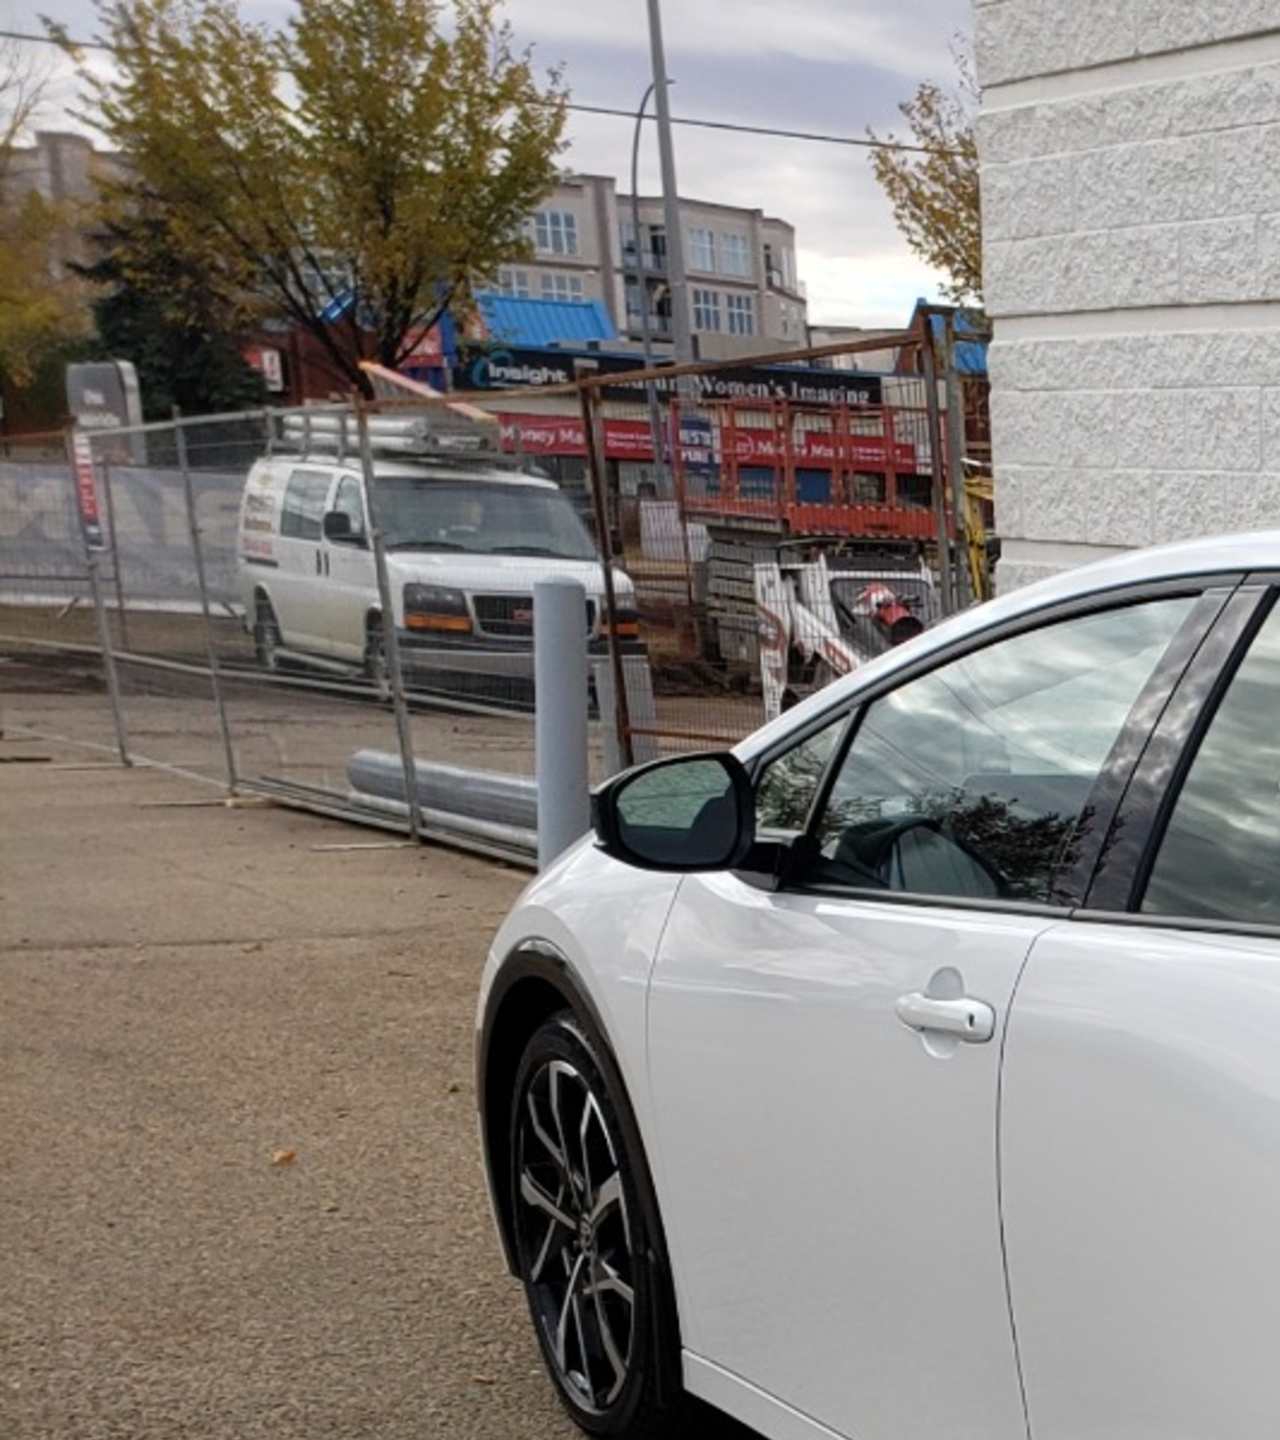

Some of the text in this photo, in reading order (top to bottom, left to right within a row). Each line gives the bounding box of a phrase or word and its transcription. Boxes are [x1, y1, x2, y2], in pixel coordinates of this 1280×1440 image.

[488, 362, 569, 385] Insight
[694, 374, 786, 400] Women's
[792, 381, 870, 406] Imaging
